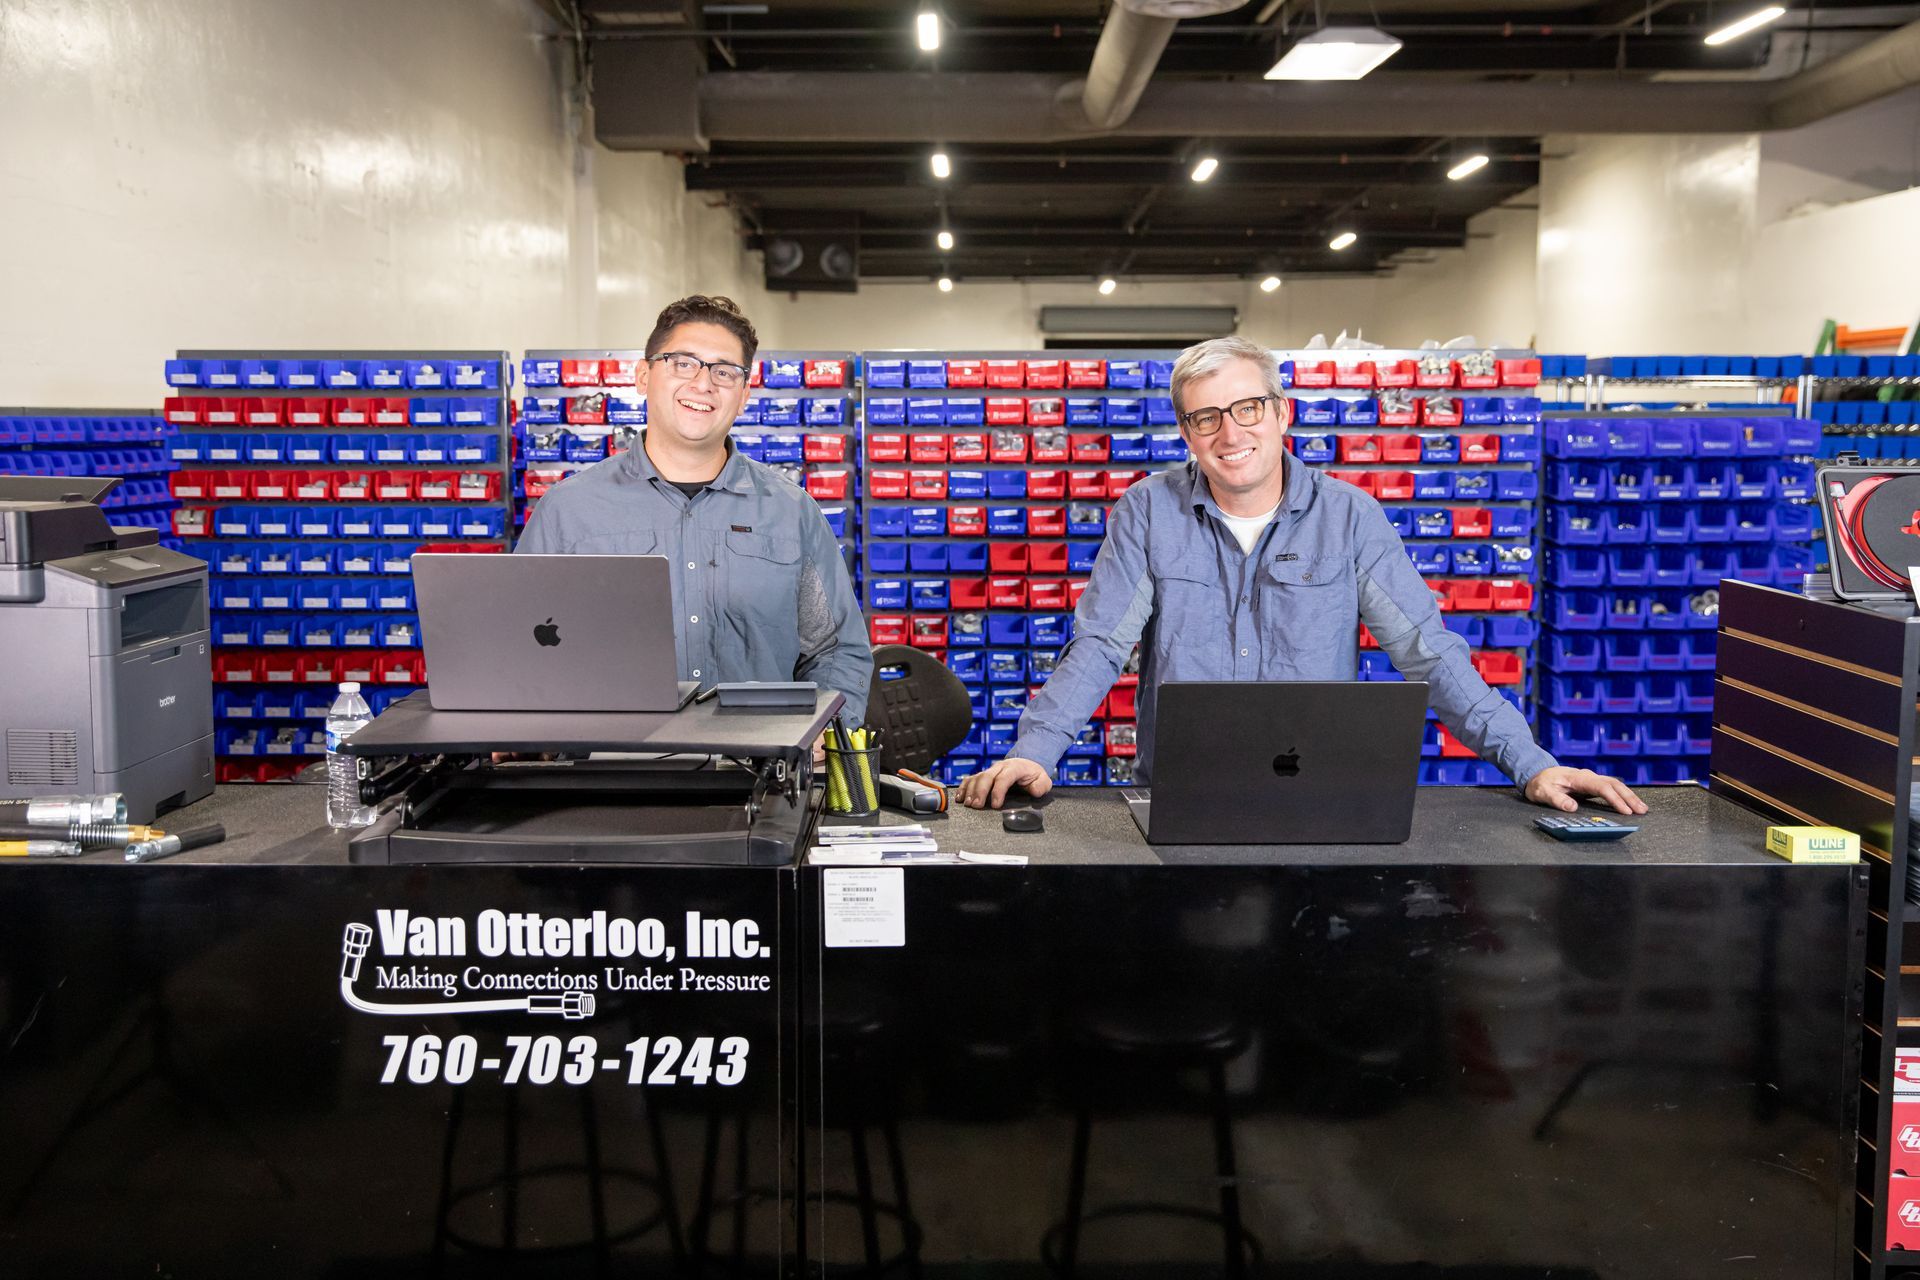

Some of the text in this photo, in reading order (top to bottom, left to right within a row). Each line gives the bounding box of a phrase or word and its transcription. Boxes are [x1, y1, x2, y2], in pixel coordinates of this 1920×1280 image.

[1811, 838, 1844, 848] ULINE
[377, 909, 771, 963] Van Otterloo, Inc.
[376, 966, 771, 996] Making Connections Under Pressure
[380, 1035, 750, 1086] 760-703-1243
